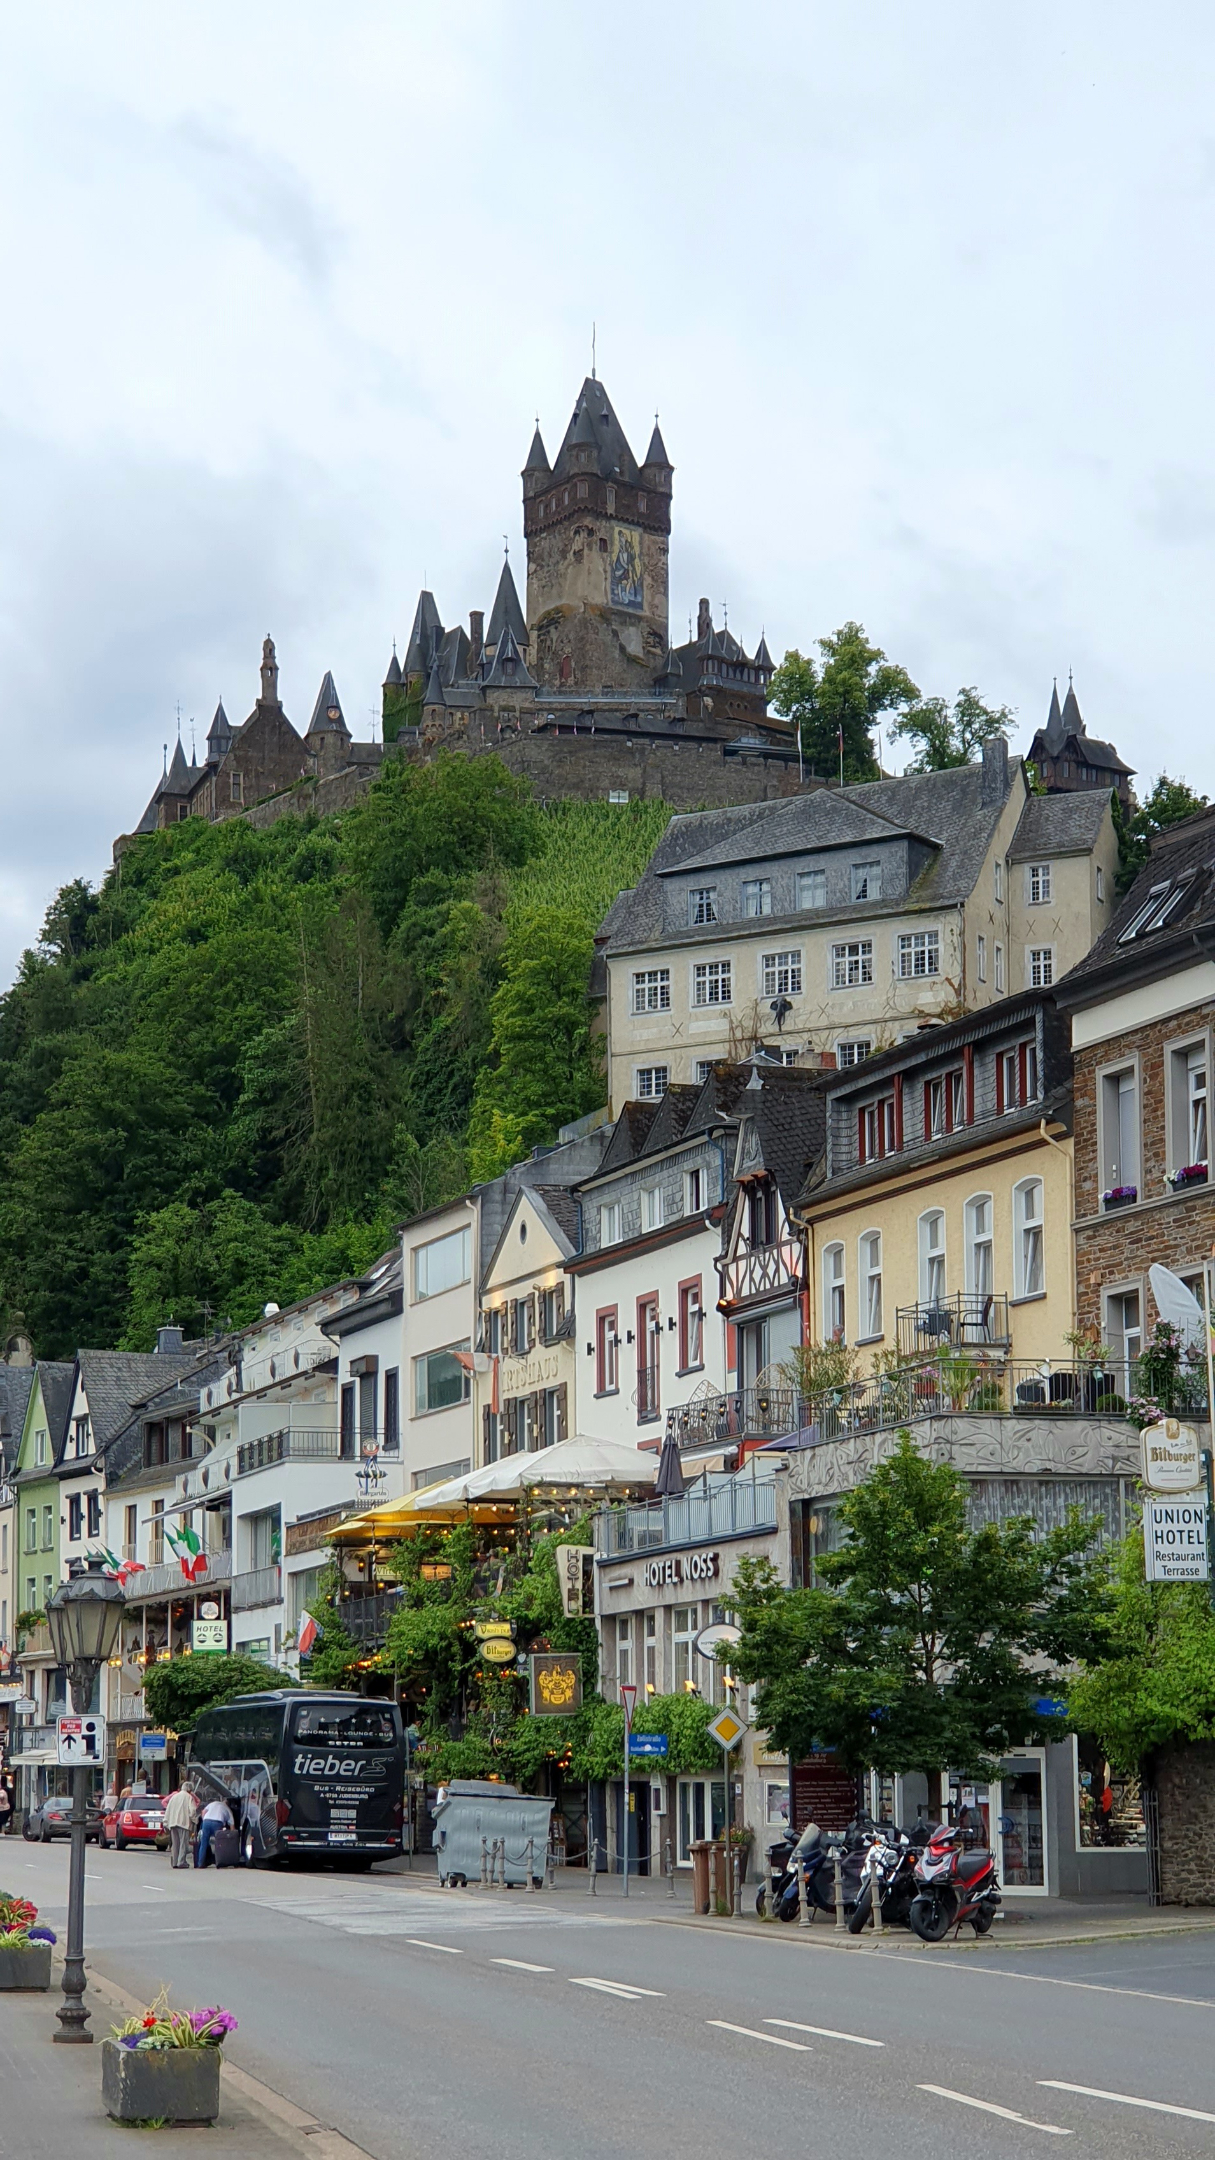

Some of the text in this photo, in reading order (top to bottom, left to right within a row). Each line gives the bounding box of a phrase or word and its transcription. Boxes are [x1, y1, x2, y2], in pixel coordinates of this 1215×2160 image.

[502, 1355, 559, 1393] IRTSHAUS
[1150, 1447, 1196, 1464] Bitburger
[1154, 1509, 1203, 1524] UNION
[1155, 1530, 1204, 1545] HOTEL
[1155, 1551, 1205, 1562] Restaurant
[644, 1552, 714, 1587] HOTEL NOSS
[1162, 1565, 1200, 1577] Terrasse
[567, 1549, 579, 1614] HOTEL
[196, 1625, 223, 1633] HOTEL
[293, 1754, 366, 1776] tieber
